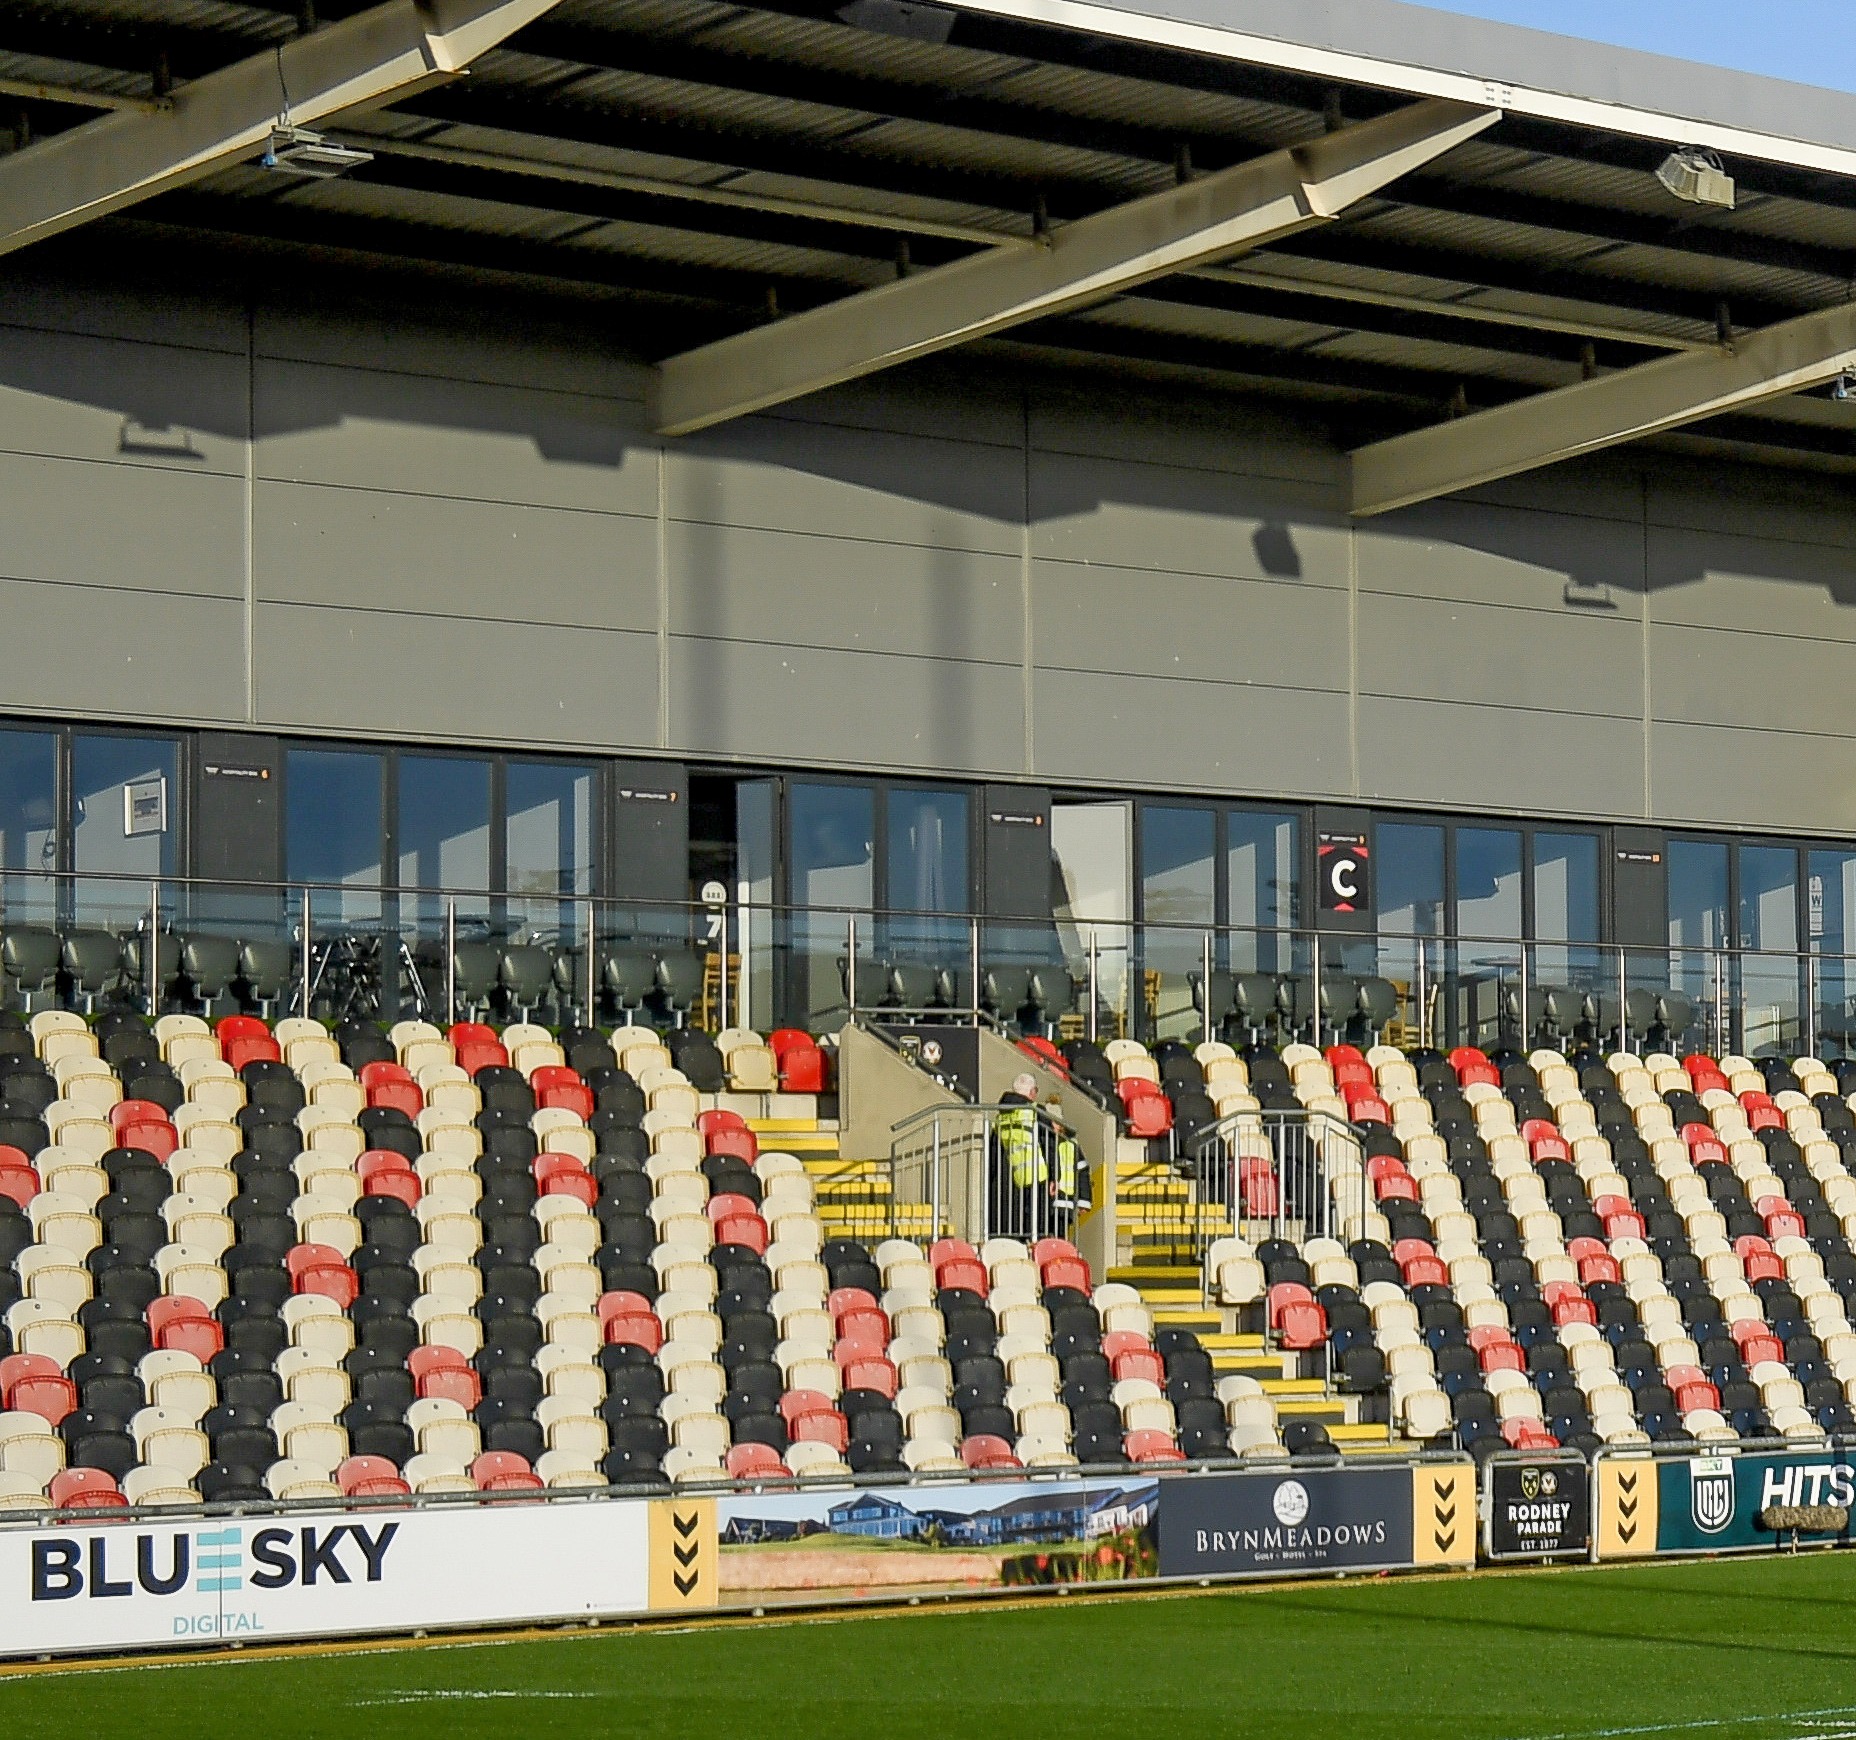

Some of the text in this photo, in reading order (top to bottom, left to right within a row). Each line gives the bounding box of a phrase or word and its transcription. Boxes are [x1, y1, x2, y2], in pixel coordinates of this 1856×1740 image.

[1331, 859, 1357, 898] C
[1761, 1464, 1855, 1512] HITS
[1508, 1503, 1571, 1521] RODNEY
[1517, 1521, 1562, 1535] PARADE
[30, 1522, 400, 1601] BLUESKY
[172, 1612, 265, 1637] DIGITAL
